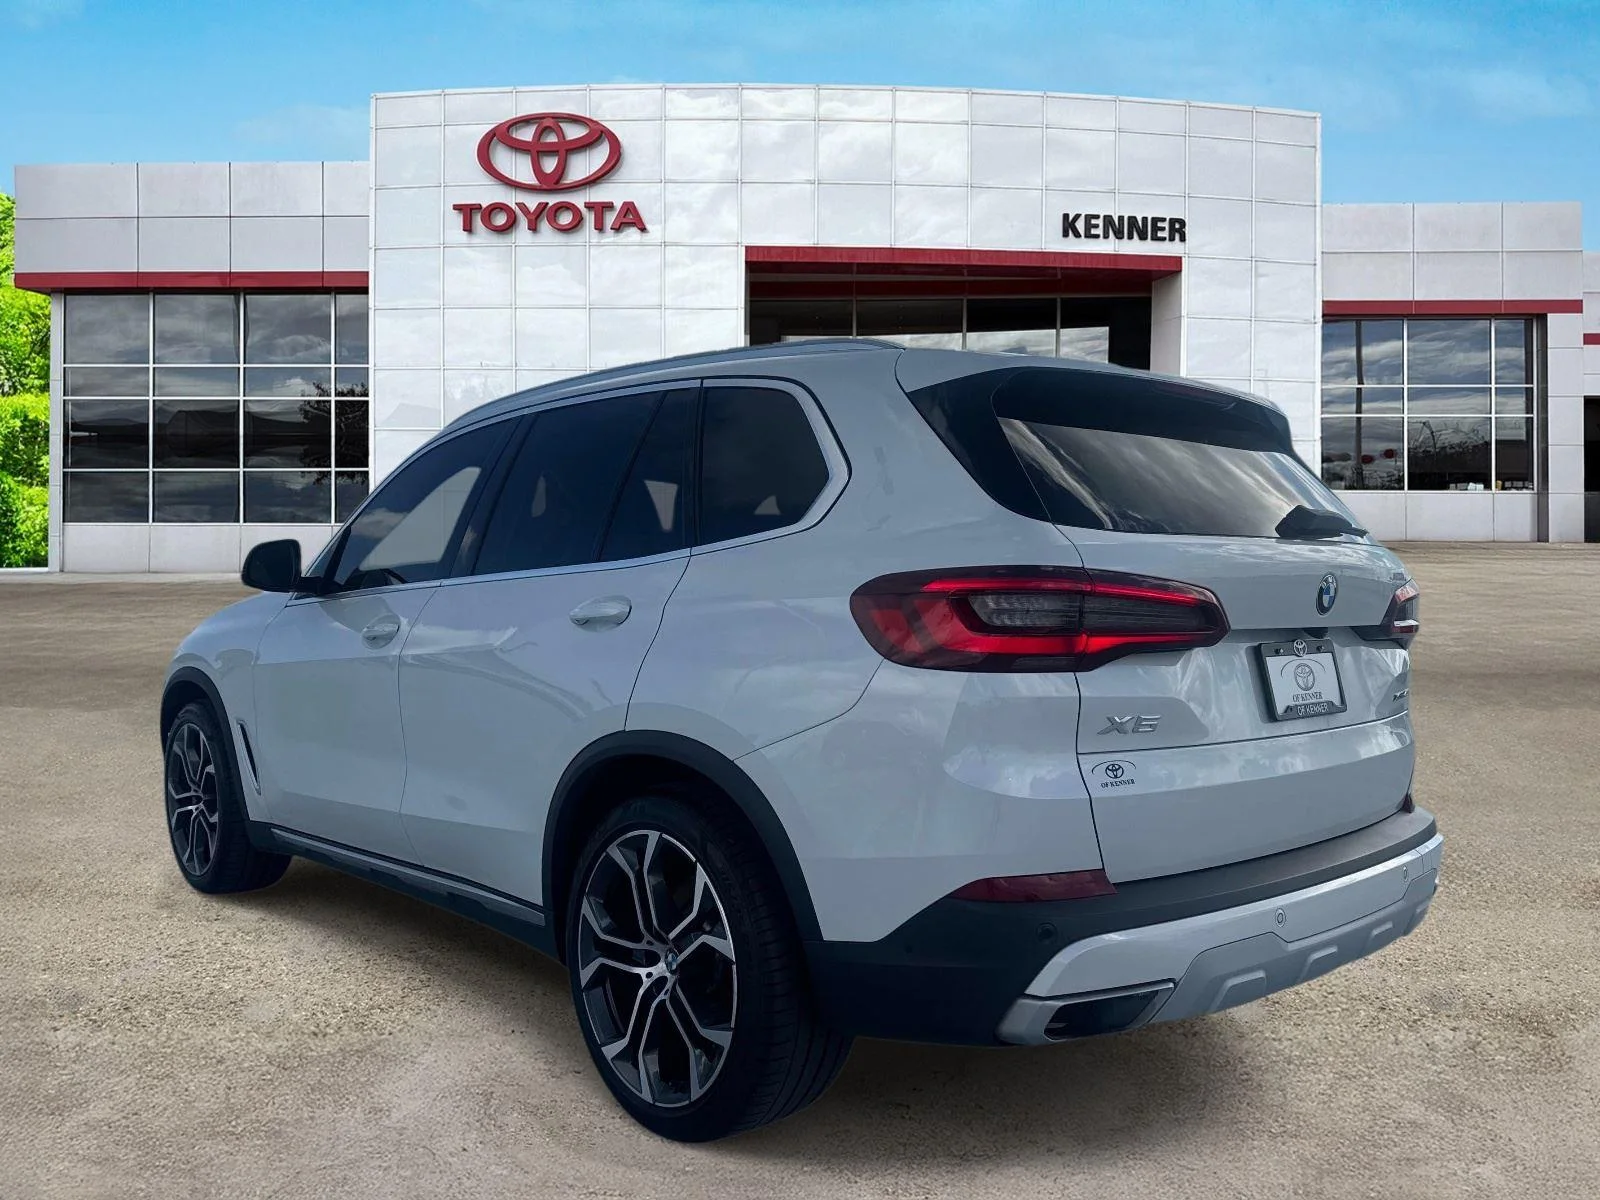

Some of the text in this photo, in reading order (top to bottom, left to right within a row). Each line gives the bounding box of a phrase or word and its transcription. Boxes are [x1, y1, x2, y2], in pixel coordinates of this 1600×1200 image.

[452, 200, 648, 233] TOYOTA
[1061, 212, 1187, 243] KENNER
[1292, 691, 1323, 703] OF KENNER
[1297, 702, 1329, 716] OF KENNER
[1096, 714, 1162, 736] X5
[1100, 778, 1136, 789] OF KENNER
